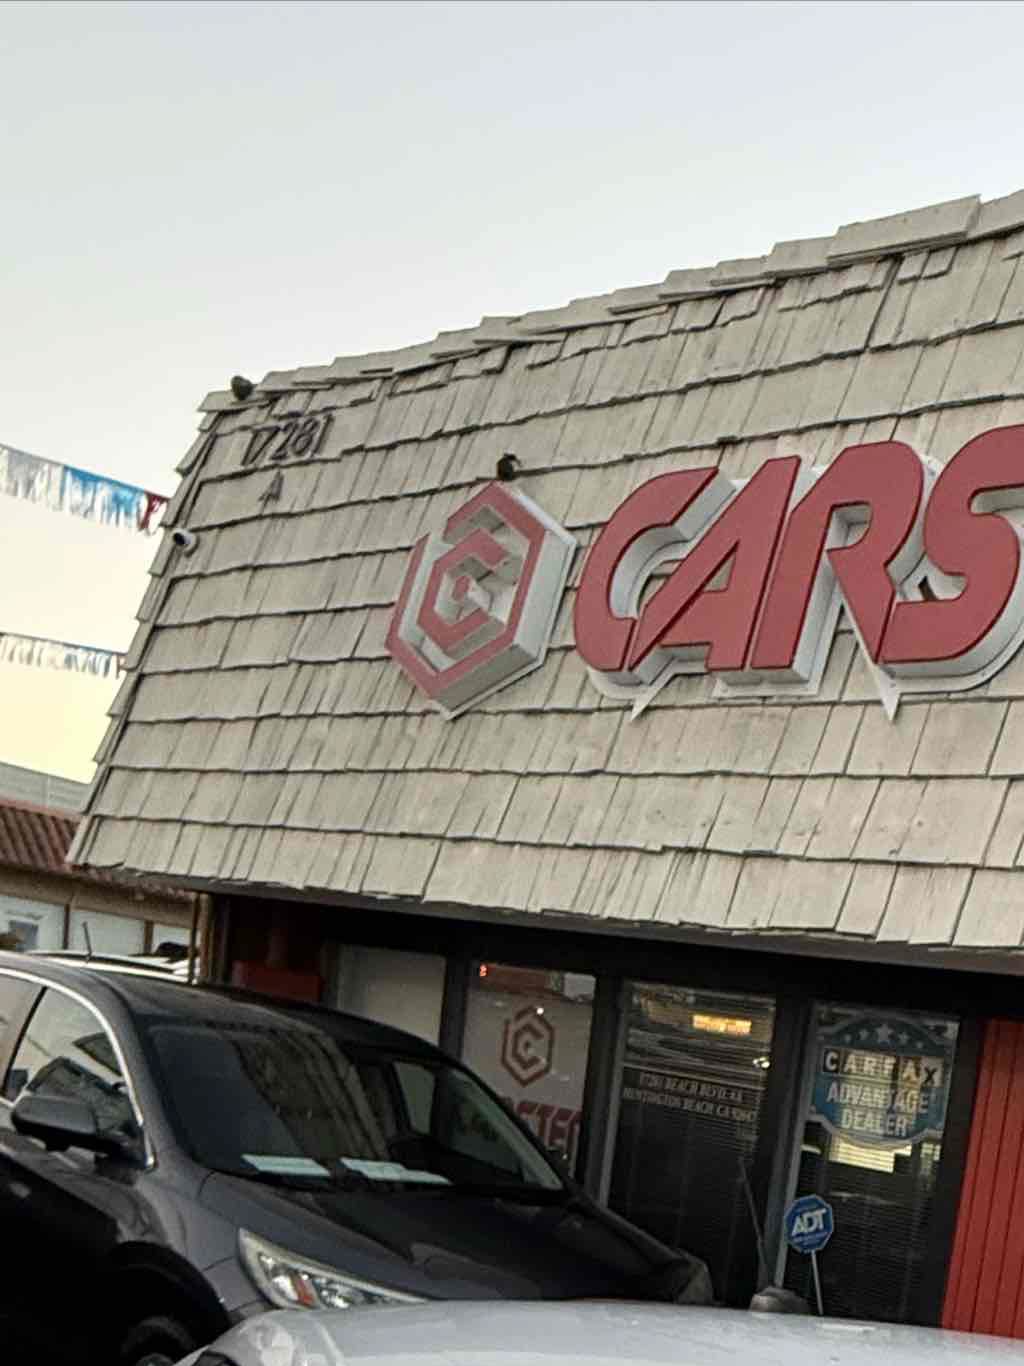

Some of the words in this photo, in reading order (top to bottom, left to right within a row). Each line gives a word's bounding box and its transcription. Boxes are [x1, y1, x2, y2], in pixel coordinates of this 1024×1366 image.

[241, 412, 335, 466] 17281
[823, 1049, 941, 1087] CARFAX
[826, 1080, 930, 1115] ADVANTAGE
[840, 1107, 909, 1137] DEALER
[791, 1207, 827, 1237] ADT
